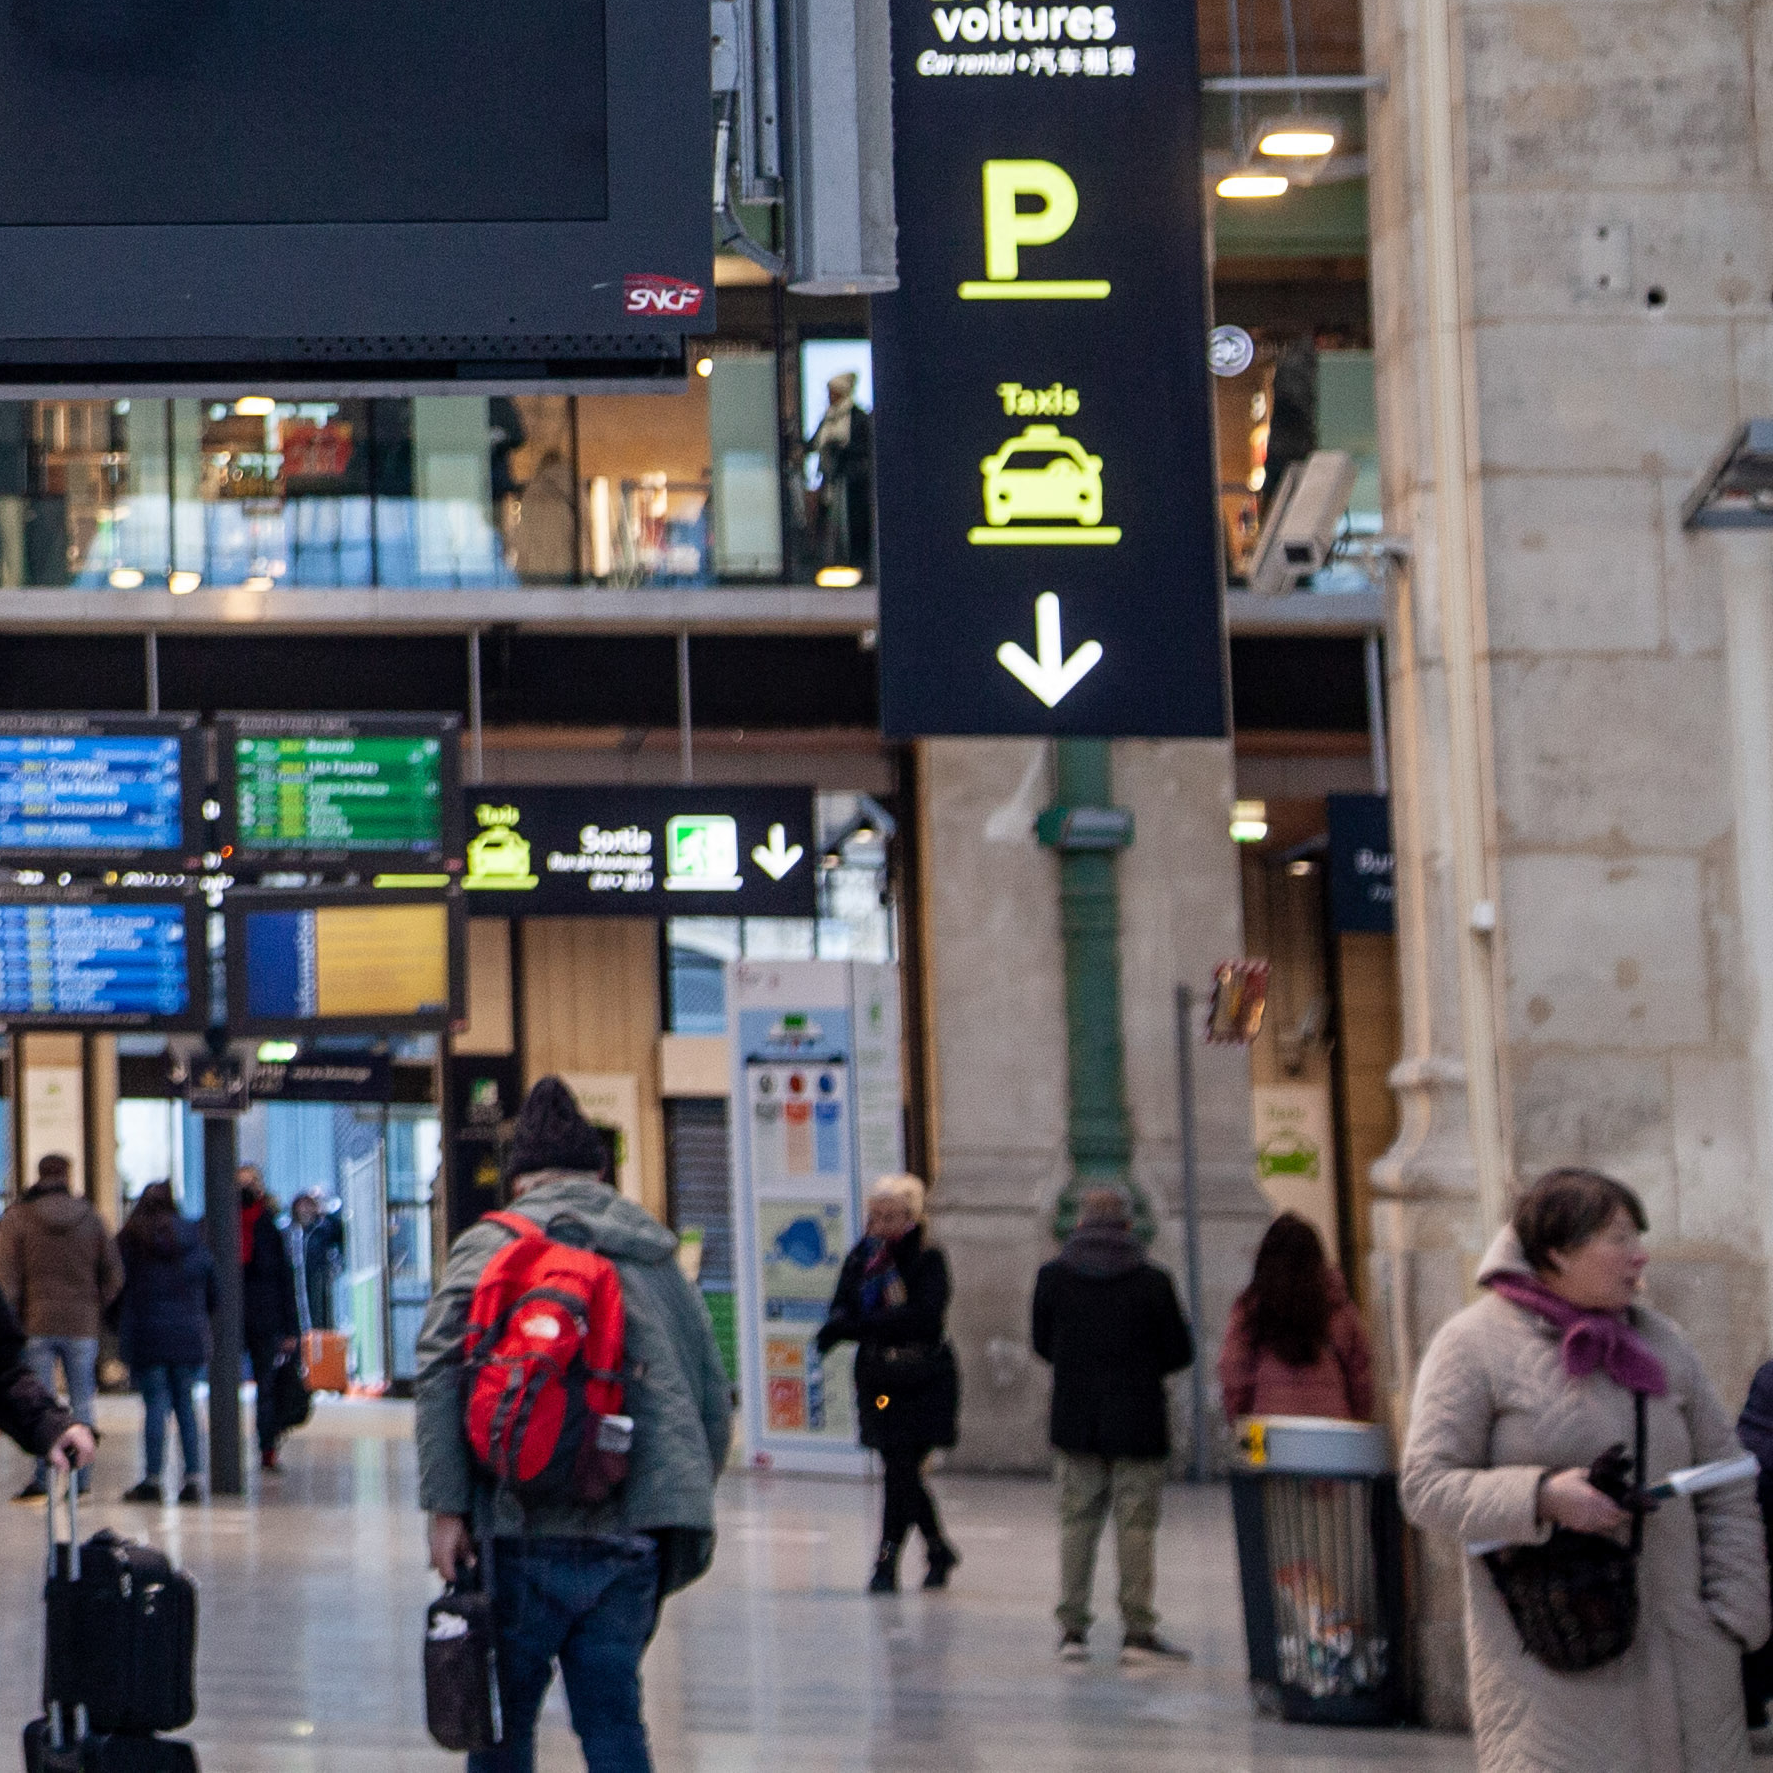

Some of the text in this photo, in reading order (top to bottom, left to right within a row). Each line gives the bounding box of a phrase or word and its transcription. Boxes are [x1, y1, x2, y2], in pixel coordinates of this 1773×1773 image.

[932, 0, 1116, 42] voitures
[982, 159, 1079, 281] P
[997, 383, 1080, 415] Taxis
[580, 825, 652, 854] Sortie
